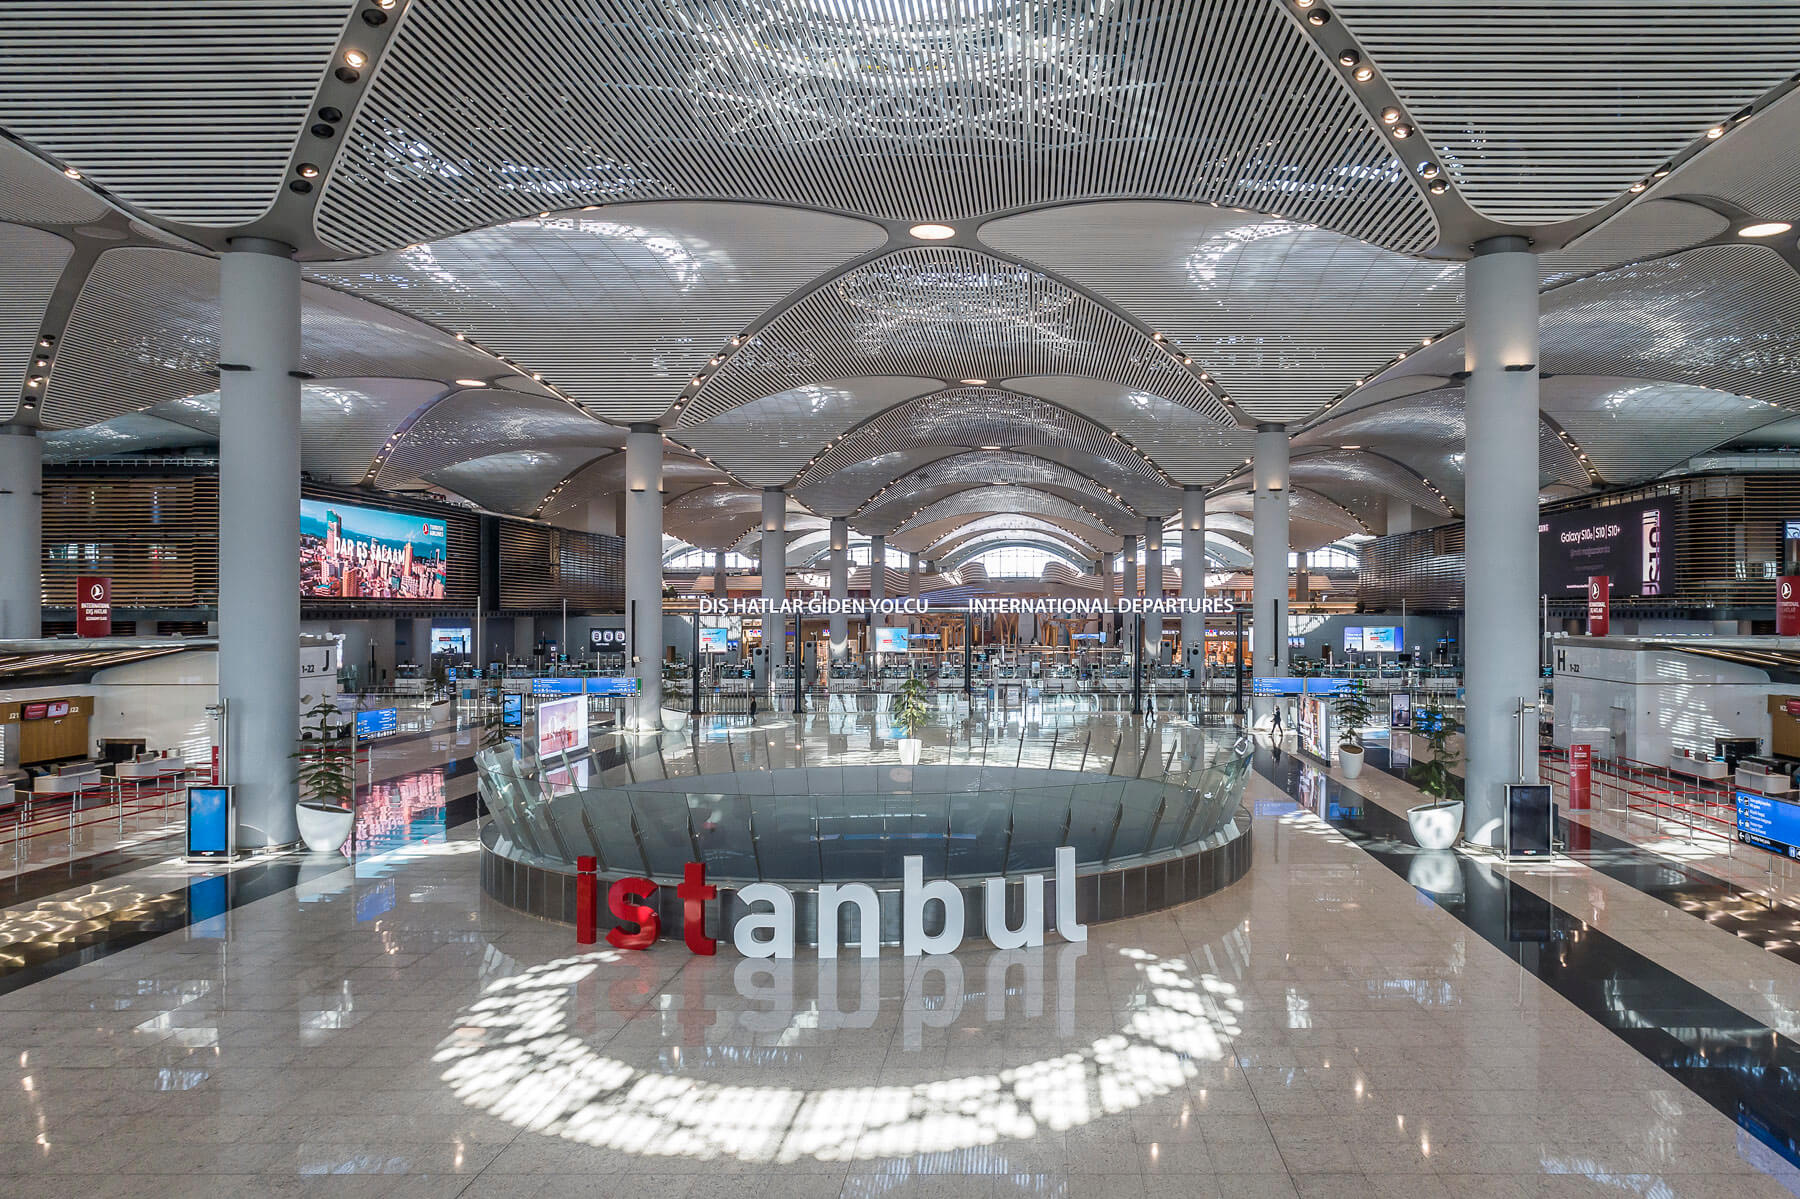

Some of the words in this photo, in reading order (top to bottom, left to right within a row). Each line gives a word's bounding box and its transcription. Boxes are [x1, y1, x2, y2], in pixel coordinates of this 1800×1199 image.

[1561, 531, 1581, 544] Galaxy
[334, 537, 354, 556] DAR
[356, 541, 368, 559] ES
[370, 544, 405, 565] SALAAM
[699, 598, 729, 617] DIŞ
[733, 598, 803, 614] HATLAR
[808, 595, 865, 614] GİDEN
[869, 598, 929, 614] YOLCU
[969, 598, 1114, 614] INTERNATIONAL
[1119, 598, 1234, 614] DEPARTURES
[302, 664, 315, 673] 1-22
[322, 650, 330, 672] J
[1557, 649, 1566, 671] H
[1569, 664, 1580, 673] 1-22
[576, 846, 1088, 959] istanbul
